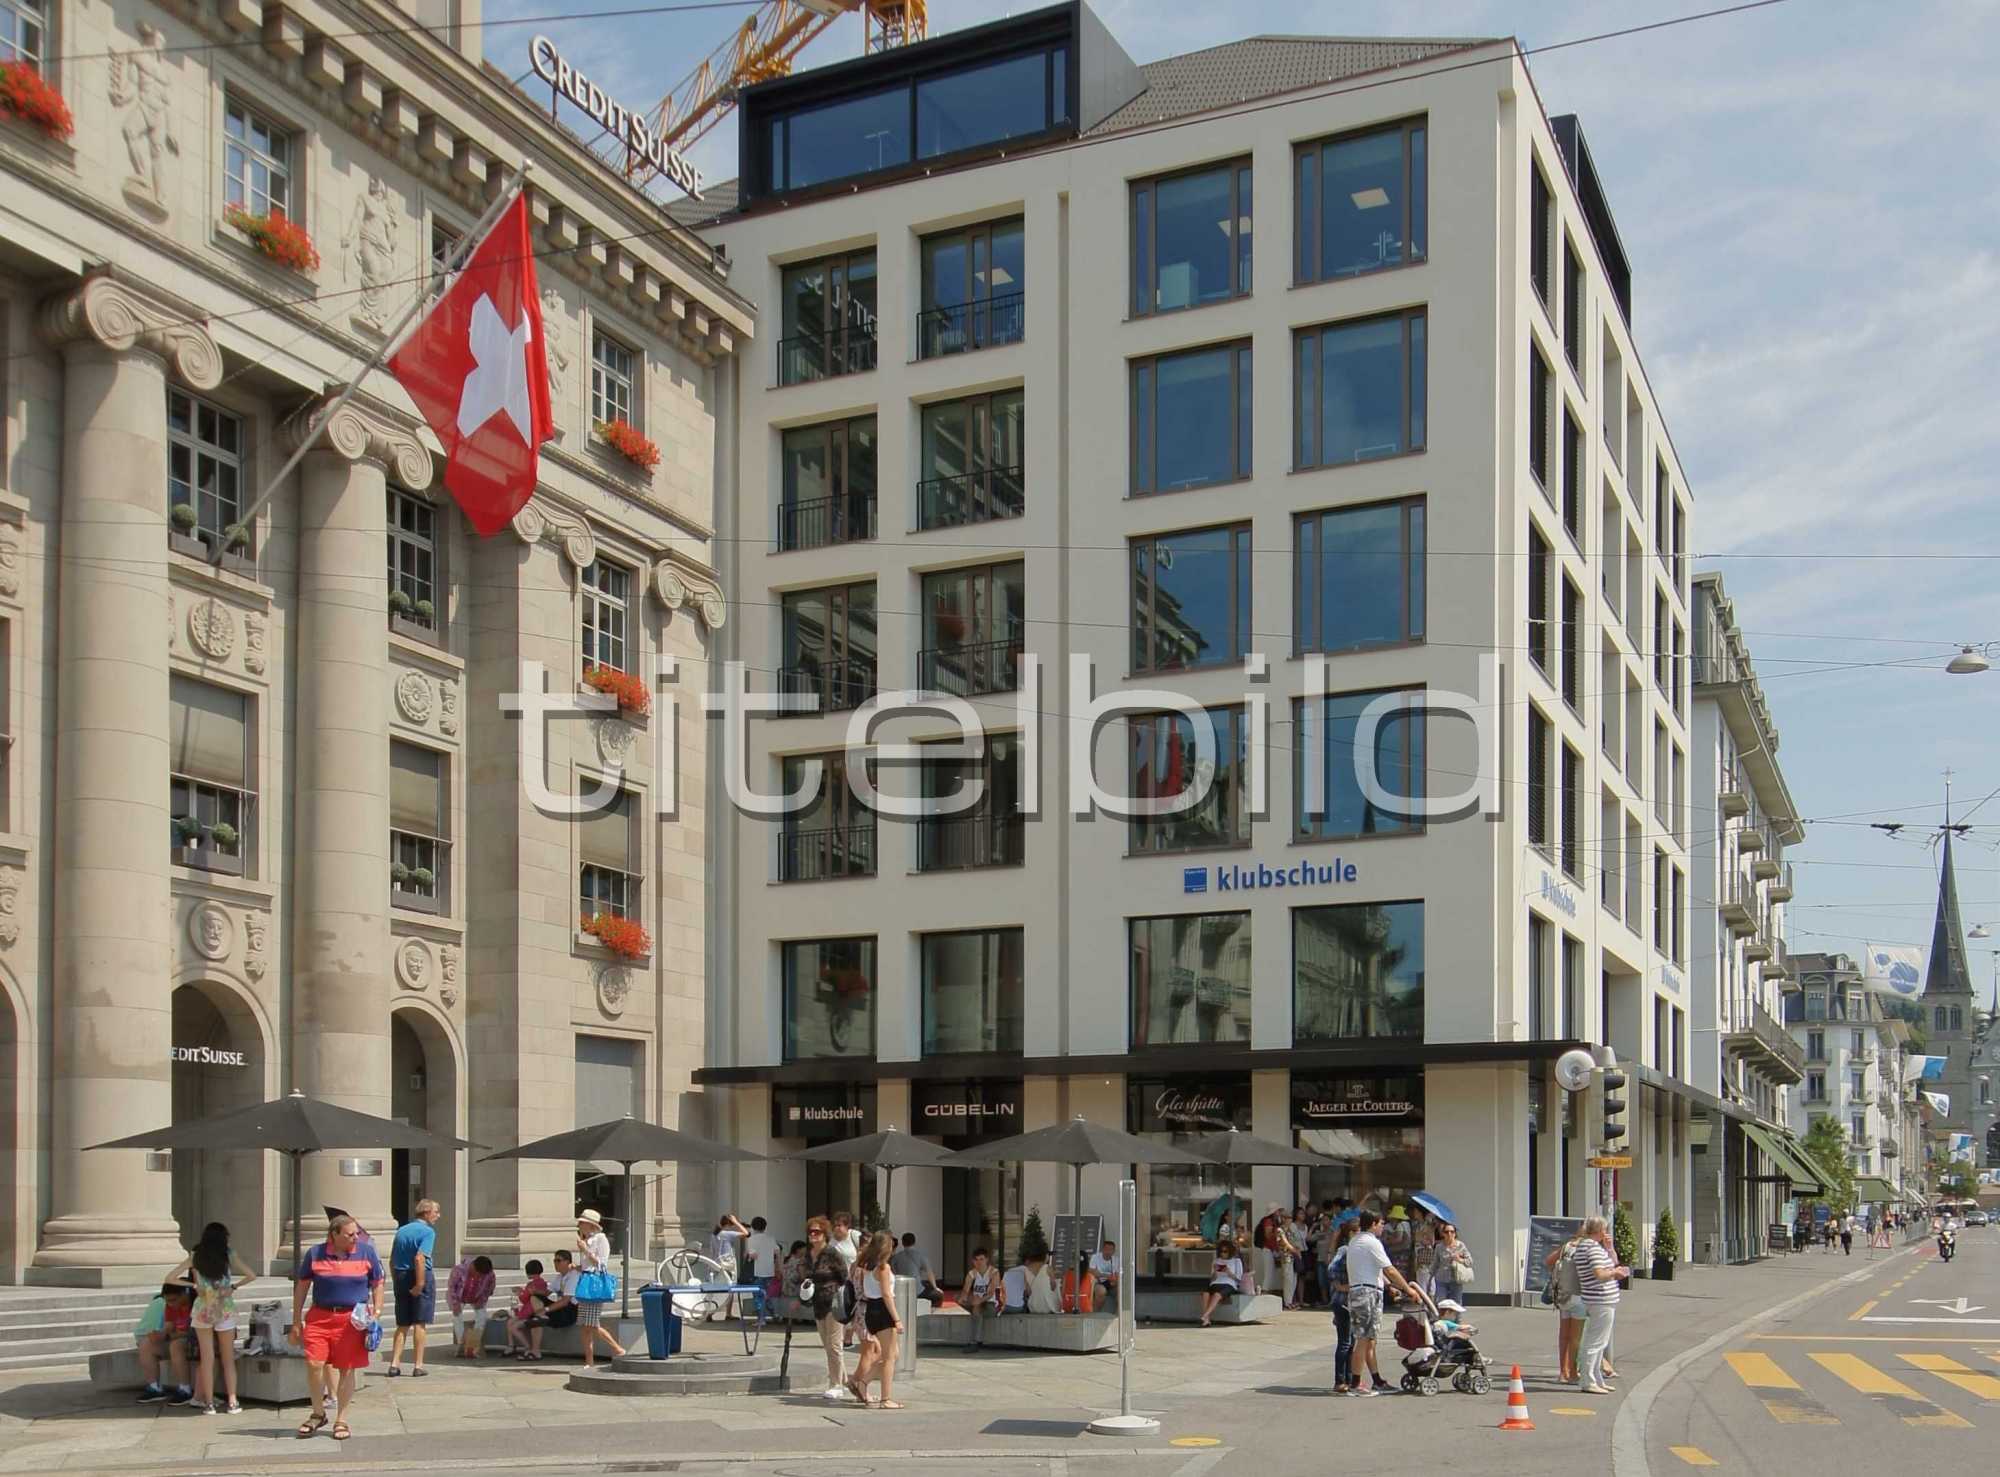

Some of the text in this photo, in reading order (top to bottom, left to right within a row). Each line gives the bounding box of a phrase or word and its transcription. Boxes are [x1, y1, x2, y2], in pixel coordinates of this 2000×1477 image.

[529, 34, 705, 201] CREDIT SUISSE
[1217, 857, 1357, 891] klubschule
[200, 1046, 248, 1066] SUISSE
[804, 1105, 865, 1121] klubschule
[924, 1103, 1015, 1116] GÜBELIN
